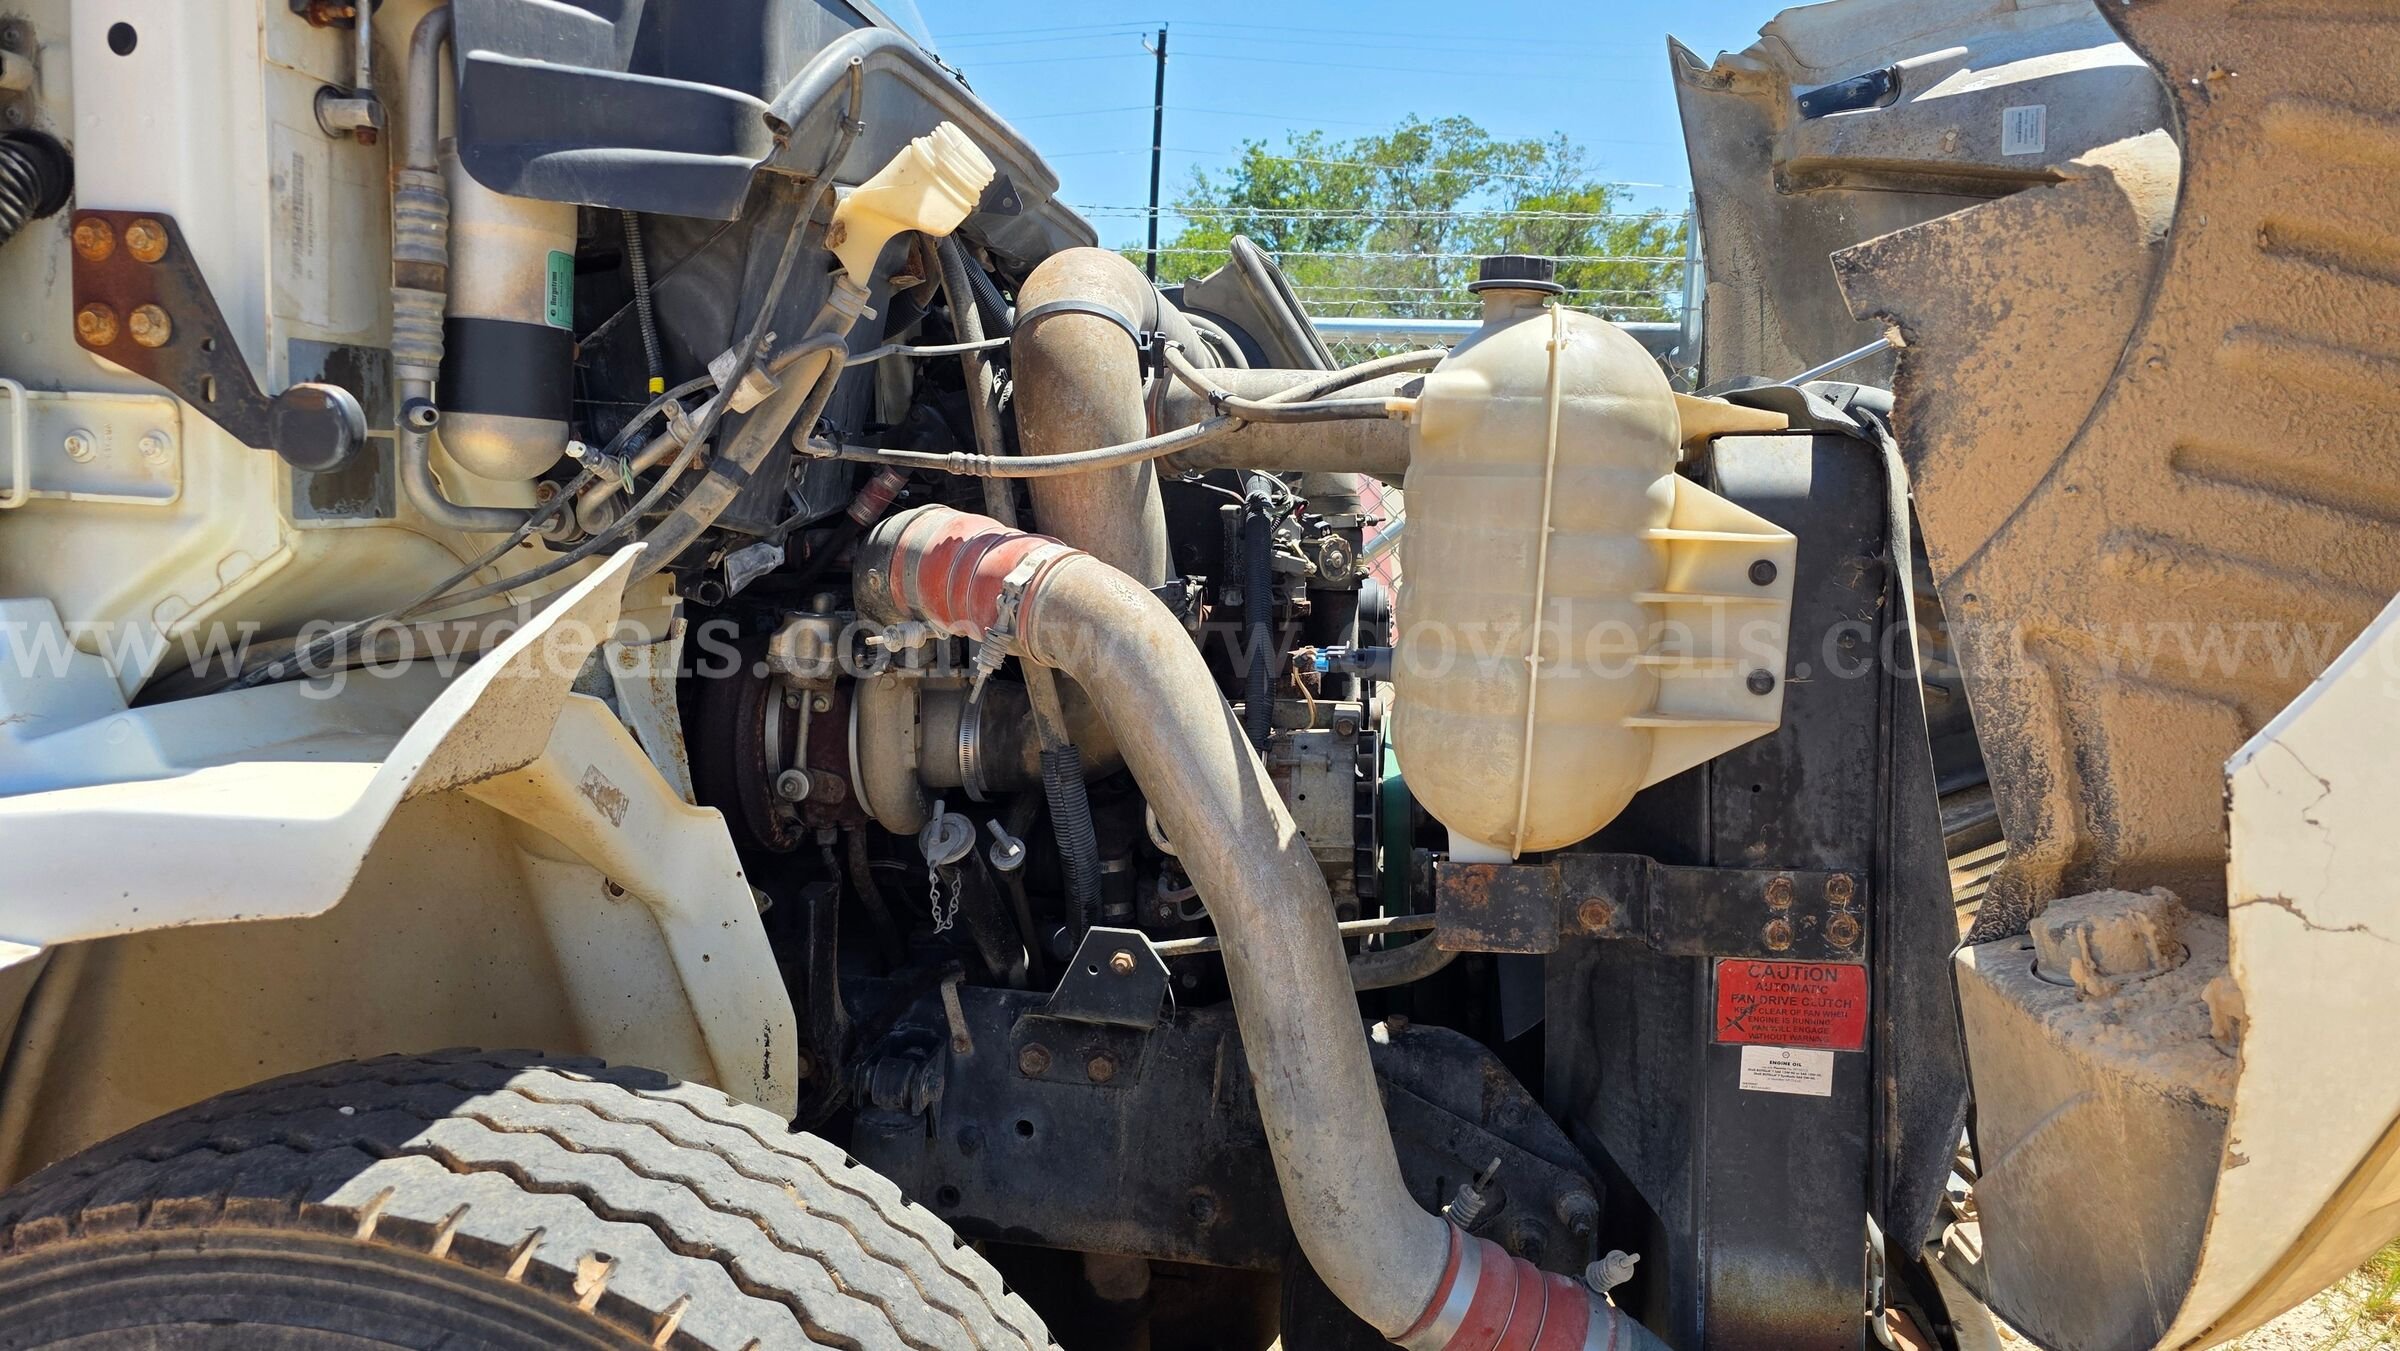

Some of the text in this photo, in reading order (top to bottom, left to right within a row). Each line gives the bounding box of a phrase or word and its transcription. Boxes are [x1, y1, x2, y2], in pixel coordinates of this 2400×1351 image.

[1748, 964, 1838, 982] CAUTION
[1755, 983, 1828, 994] AUTOMATIC
[1731, 993, 1852, 1008] FAN DRIVE CLUTCH
[1748, 1016, 1780, 1024] ENGINE
[1793, 1026, 1829, 1034] ENGAGE
[1749, 1033, 1829, 1043] WITHOUT WARNING
